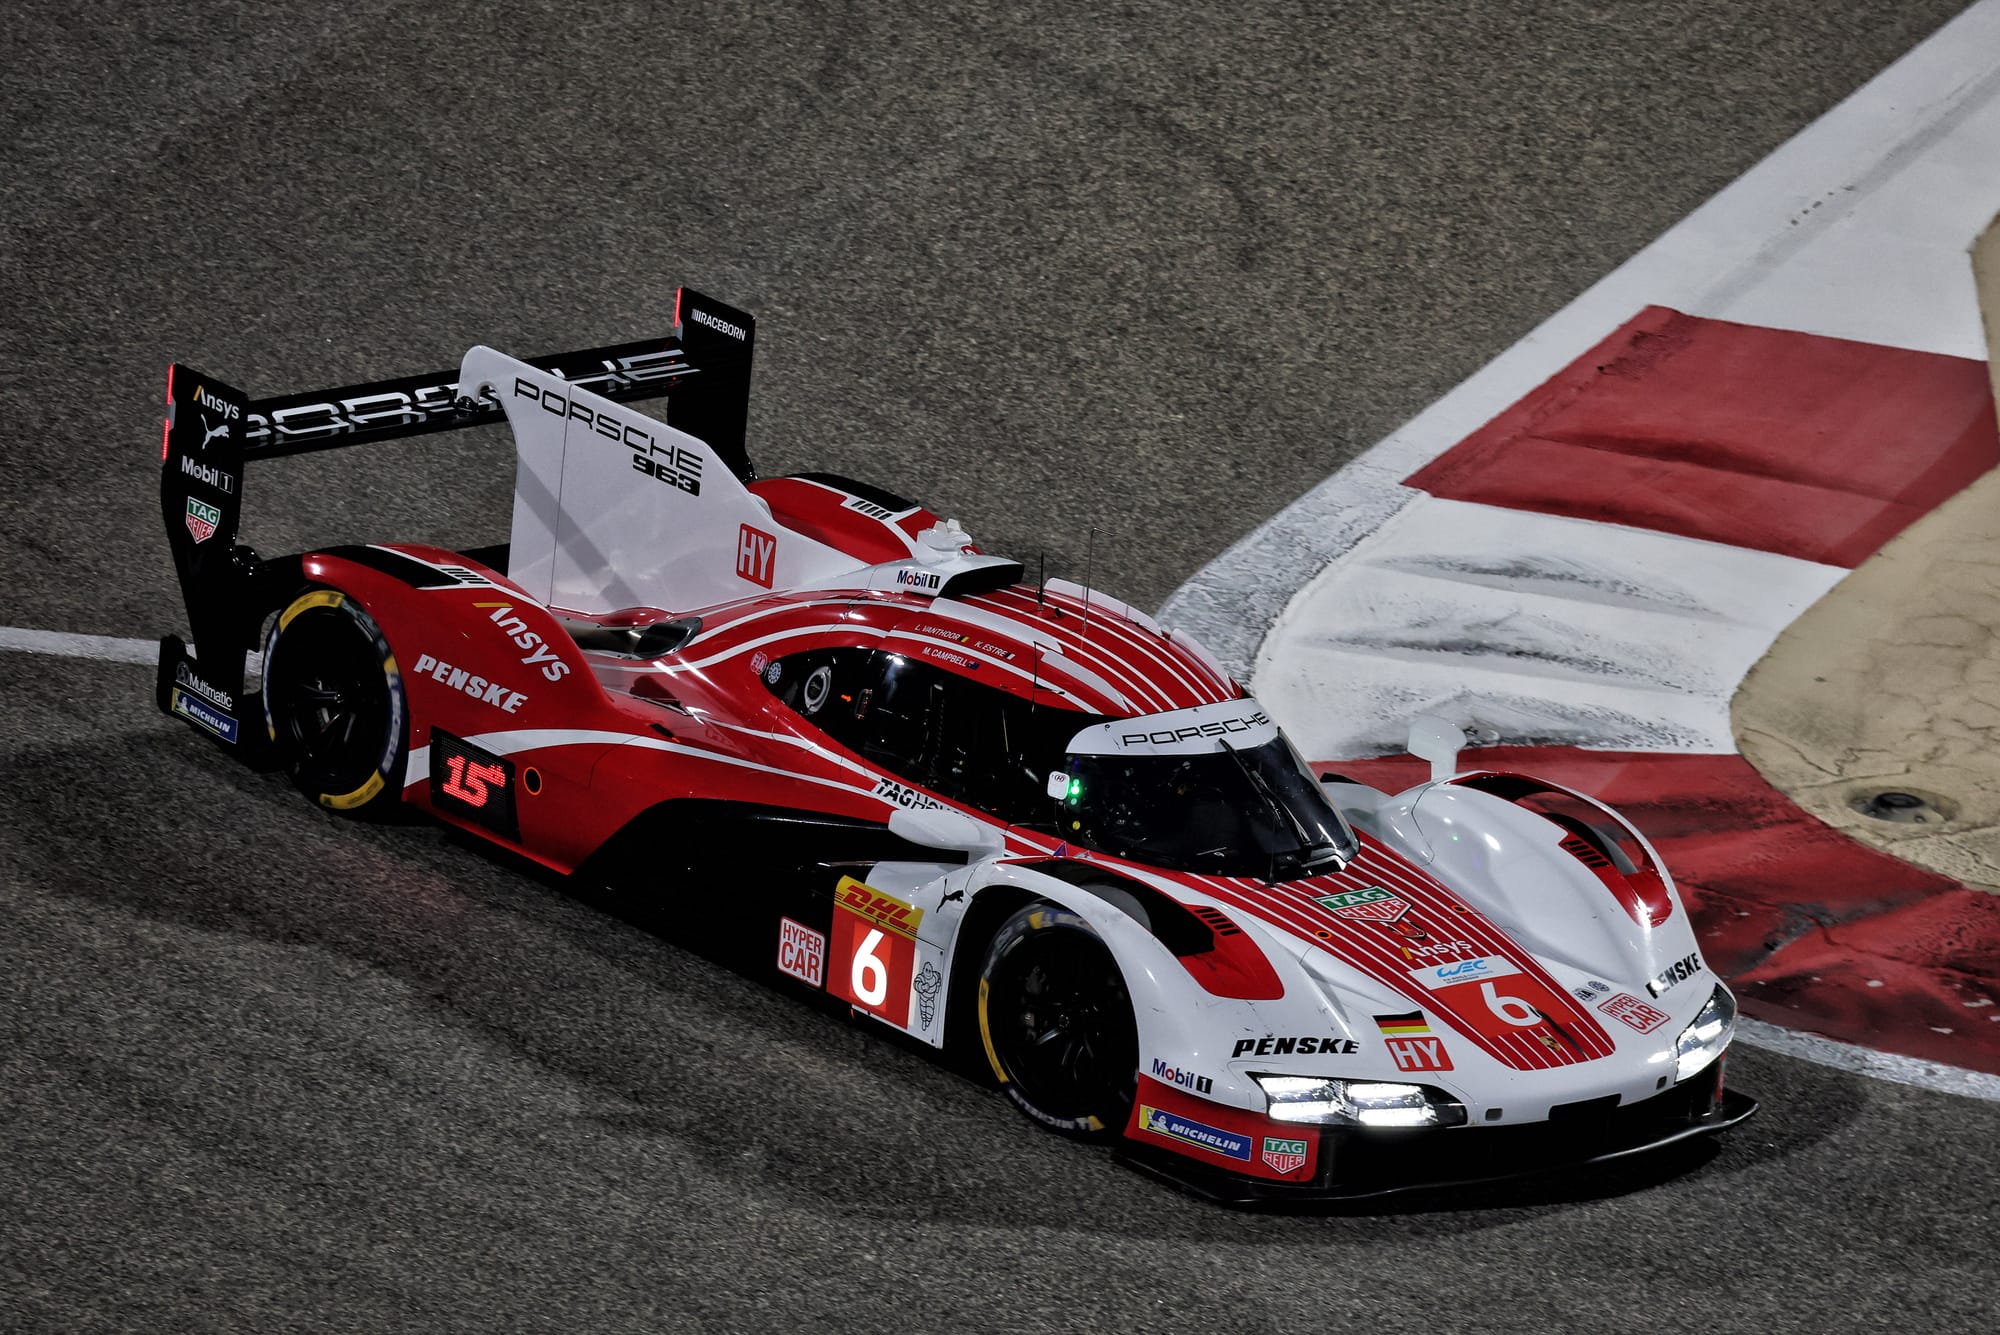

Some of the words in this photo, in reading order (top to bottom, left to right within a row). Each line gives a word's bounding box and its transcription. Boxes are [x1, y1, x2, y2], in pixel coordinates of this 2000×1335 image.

[700, 310, 746, 341] RACEBORN
[193, 384, 241, 419] Ansys
[514, 377, 703, 477] PORSCHE
[182, 455, 218, 487] Mobil
[632, 454, 700, 496] 963
[190, 501, 217, 523] TAG
[187, 515, 212, 541] HEUER
[739, 530, 774, 581] HY
[897, 570, 928, 588] Mobil
[472, 602, 570, 682] Ansys
[922, 625, 961, 641] VANTHOOR
[922, 647, 930, 655] M.
[931, 649, 968, 667] CAMPBELL
[982, 643, 1008, 657] ESTRE
[189, 672, 232, 708] Multimatic
[413, 654, 528, 714] PENSKE
[189, 705, 231, 733] MICHELIN
[1122, 712, 1270, 746] PORSCHE
[842, 885, 911, 929] DHL
[1320, 890, 1388, 906] TAG
[1338, 899, 1405, 919] HEUER
[783, 922, 822, 956] HYPER
[1401, 940, 1472, 960] Ansys
[780, 941, 820, 983] CAR
[851, 929, 888, 1006] 6
[1437, 960, 1487, 977] WEC
[1480, 981, 1542, 1027] 6
[1603, 996, 1640, 1017] HYPER
[1621, 1005, 1664, 1030] CAR
[1231, 1036, 1360, 1058] PENSKE
[1389, 1039, 1443, 1068] HY
[1152, 1057, 1194, 1089] Mobil
[1170, 1122, 1241, 1151] MICHELIN
[1269, 1140, 1303, 1154] TAG
[1265, 1153, 1303, 1171] HEUER
